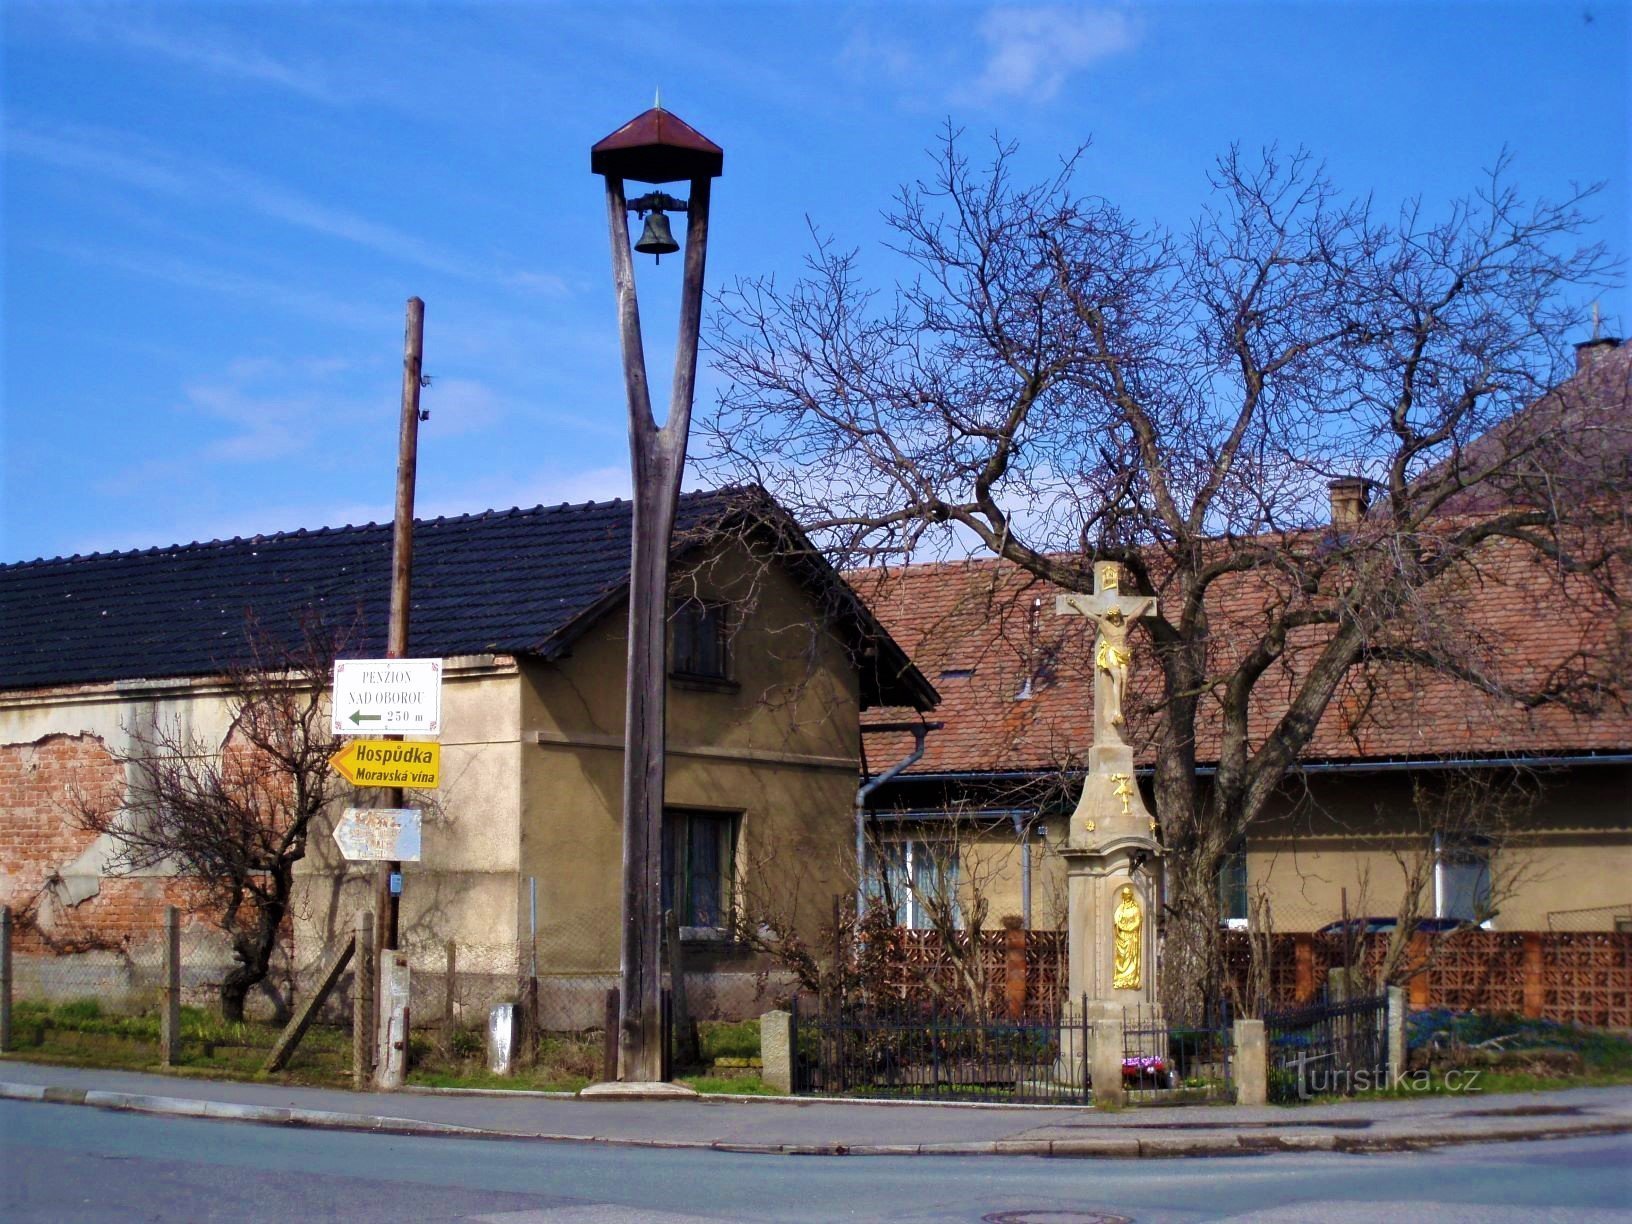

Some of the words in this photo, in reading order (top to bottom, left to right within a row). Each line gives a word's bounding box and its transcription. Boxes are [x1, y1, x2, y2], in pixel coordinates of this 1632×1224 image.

[362, 671, 412, 684] PENZION
[348, 691, 372, 704] NAD
[375, 691, 425, 704] OBOROU
[387, 710, 409, 722] 250
[415, 714, 423, 722] m
[356, 745, 433, 766] Hospůdka
[355, 767, 408, 782] Moravská
[411, 770, 435, 783] vína
